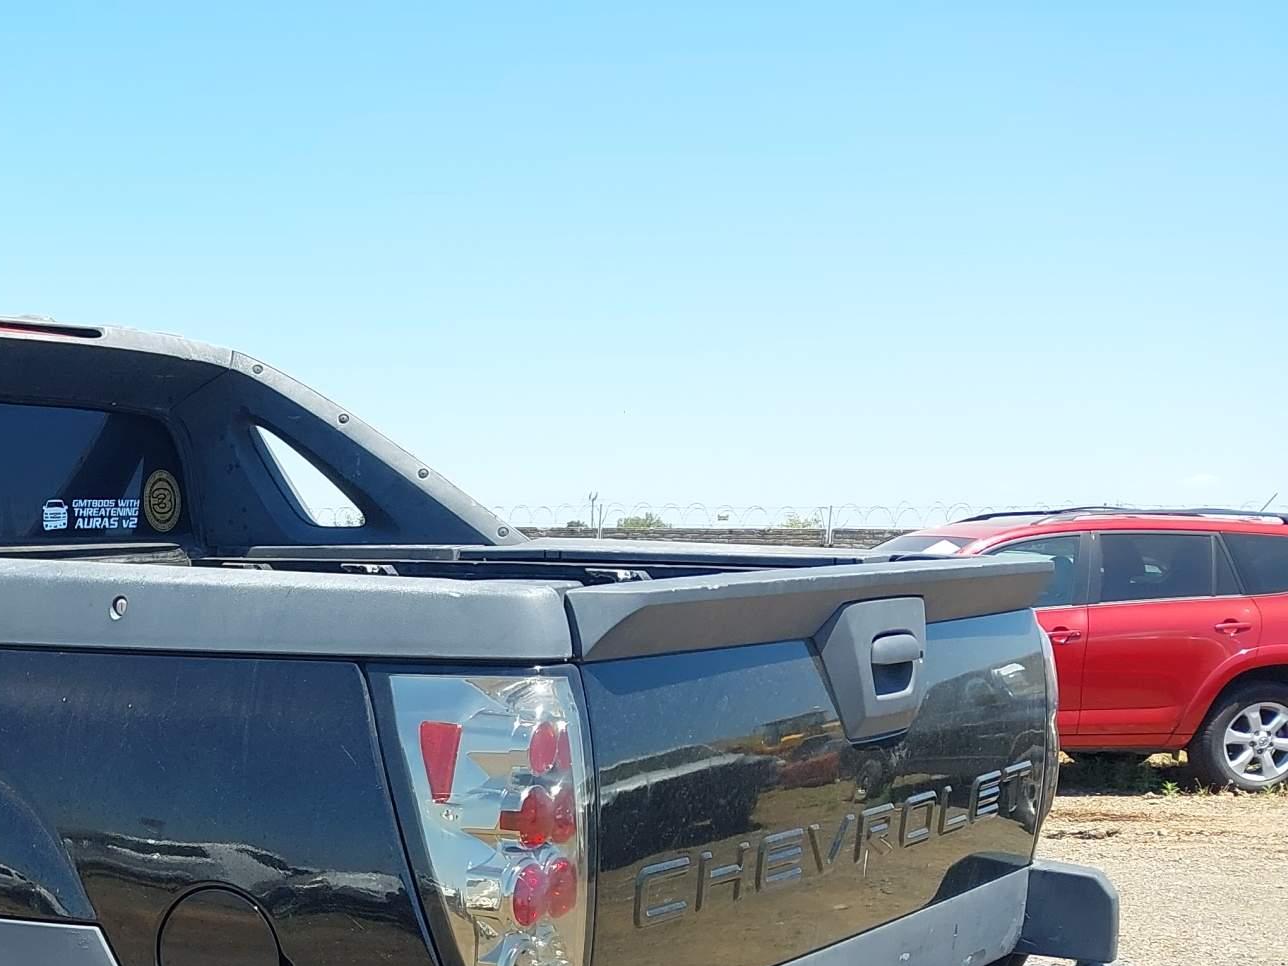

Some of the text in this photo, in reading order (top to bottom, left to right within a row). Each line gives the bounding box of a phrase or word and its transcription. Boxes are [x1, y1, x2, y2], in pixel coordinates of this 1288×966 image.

[117, 499, 140, 508] WITH
[74, 507, 140, 517] THREATENING
[74, 517, 119, 529] AURAS
[633, 759, 1034, 928] CHEVROLET
